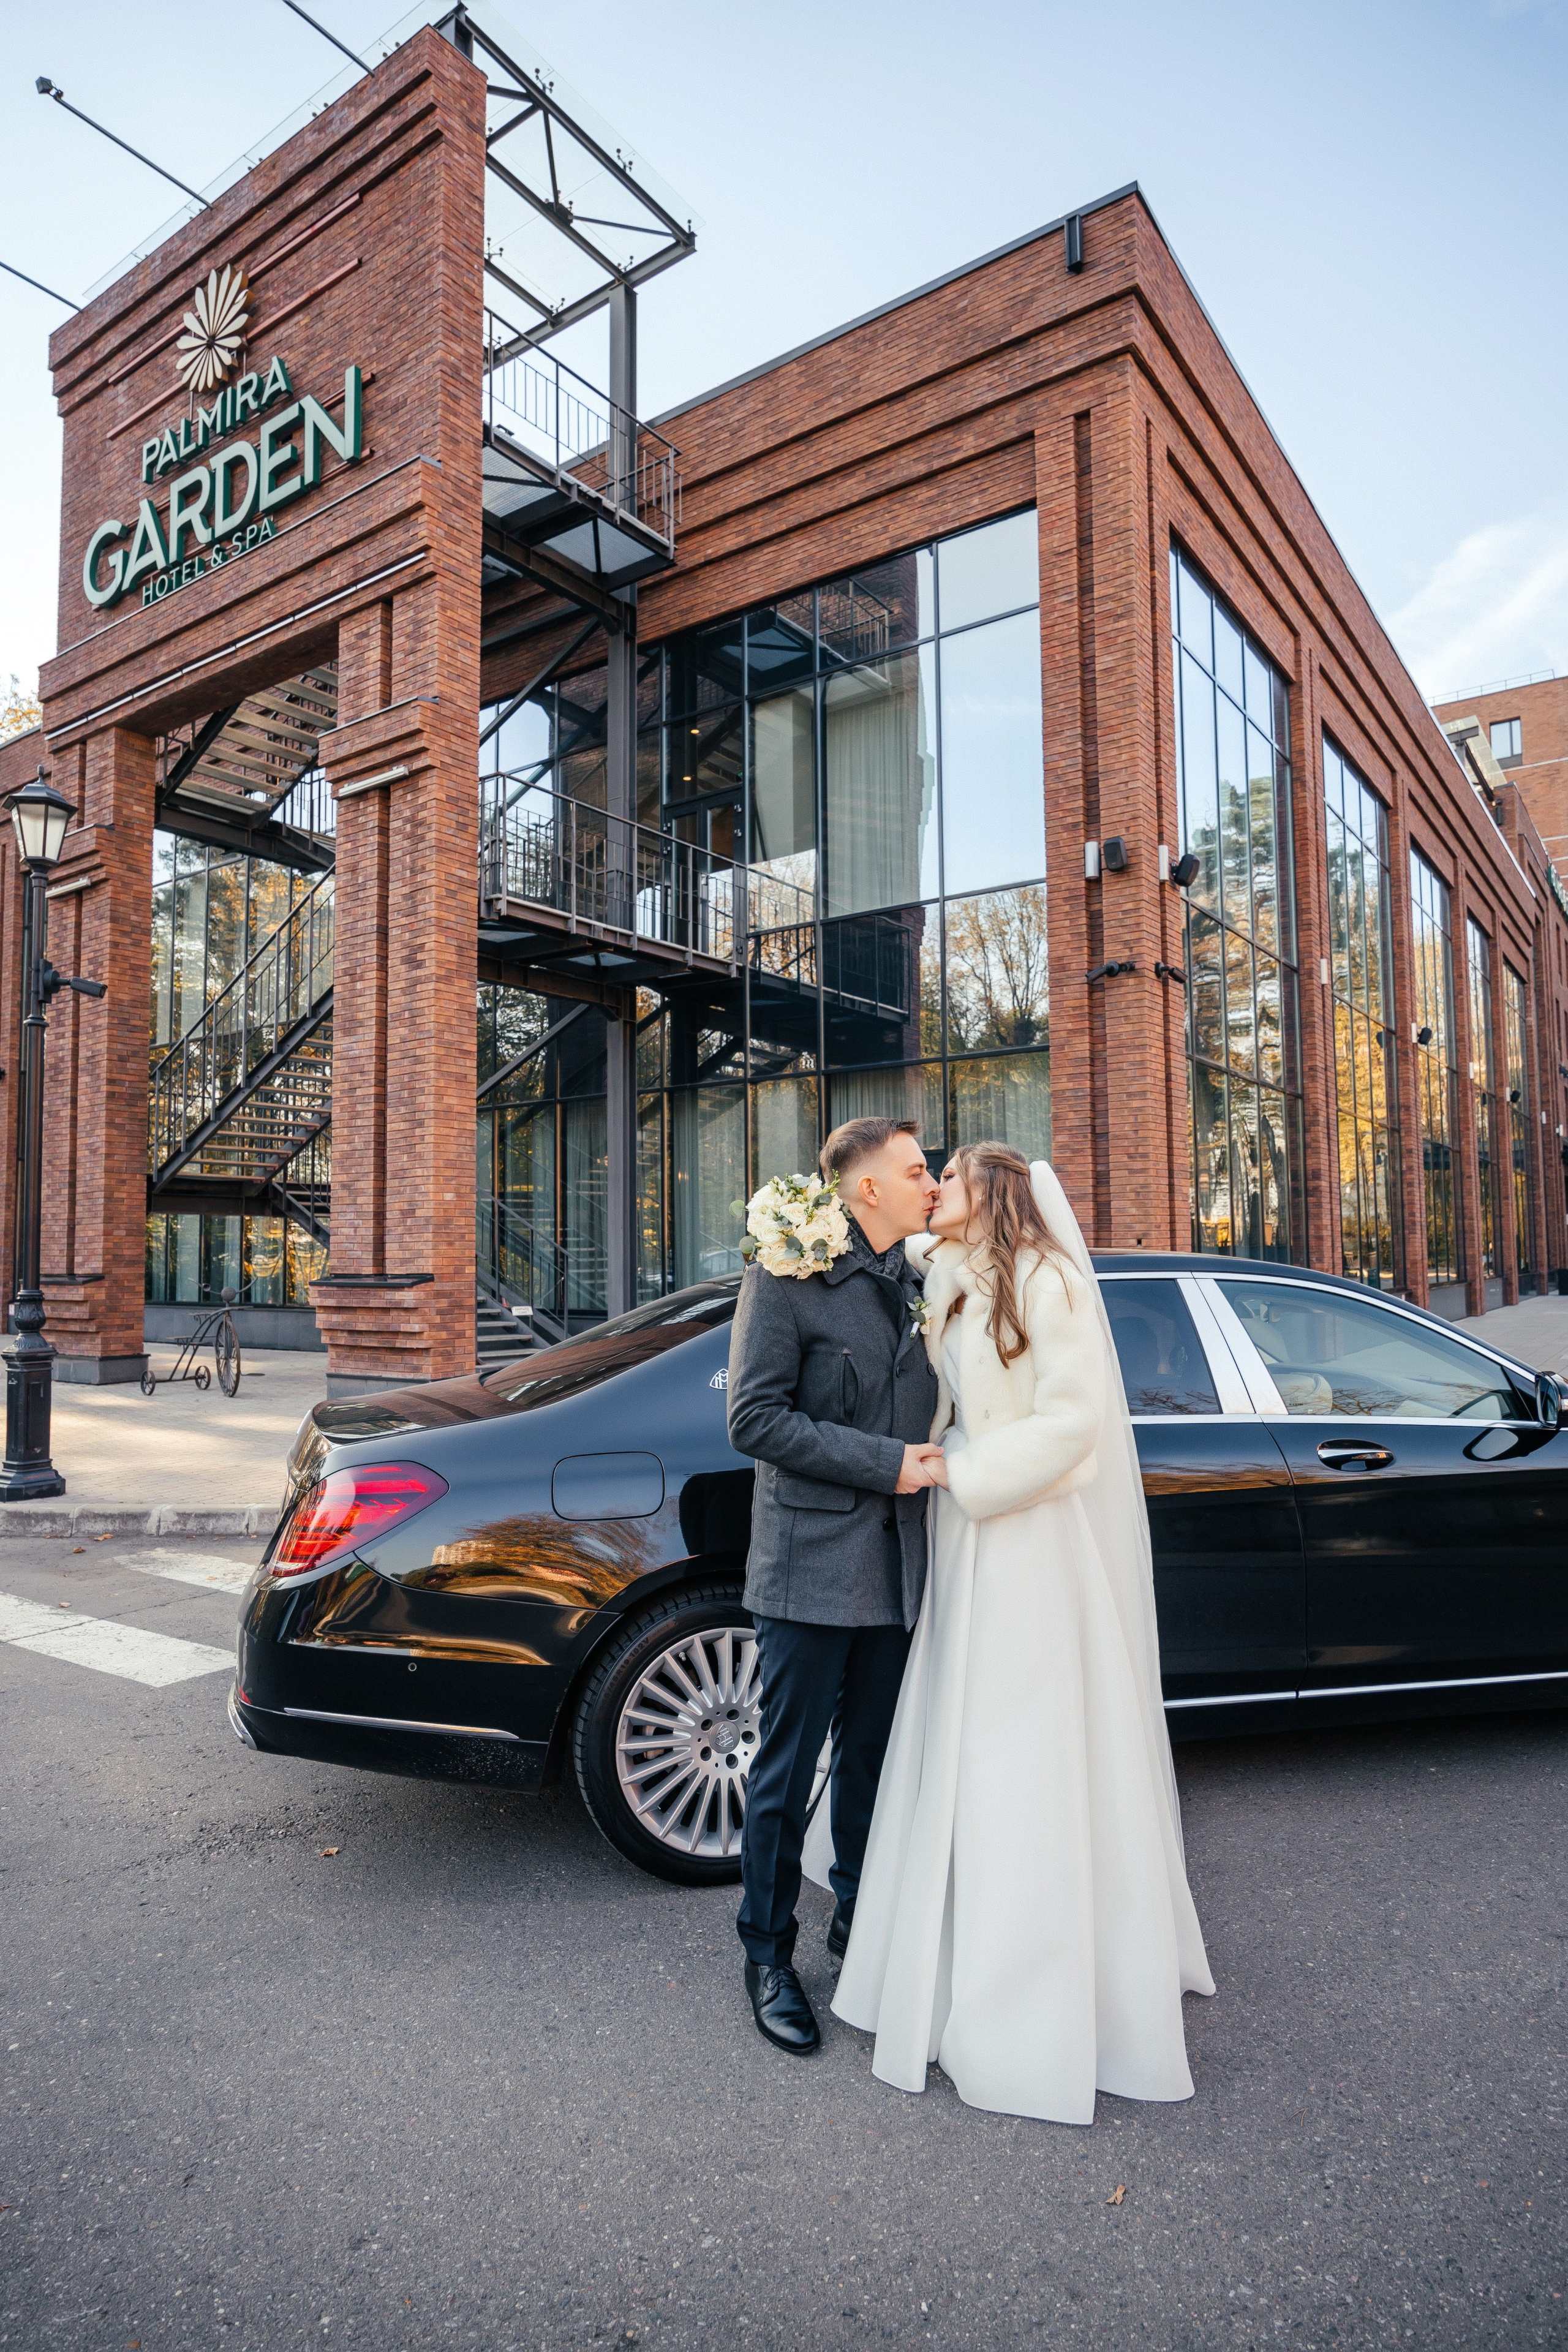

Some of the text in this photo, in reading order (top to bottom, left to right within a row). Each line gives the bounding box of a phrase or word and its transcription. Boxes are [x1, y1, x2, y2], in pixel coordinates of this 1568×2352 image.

[142, 356, 293, 483] PALMIRA
[83, 365, 361, 606] GARDEN
[143, 518, 275, 606] HOTEL & SPA
